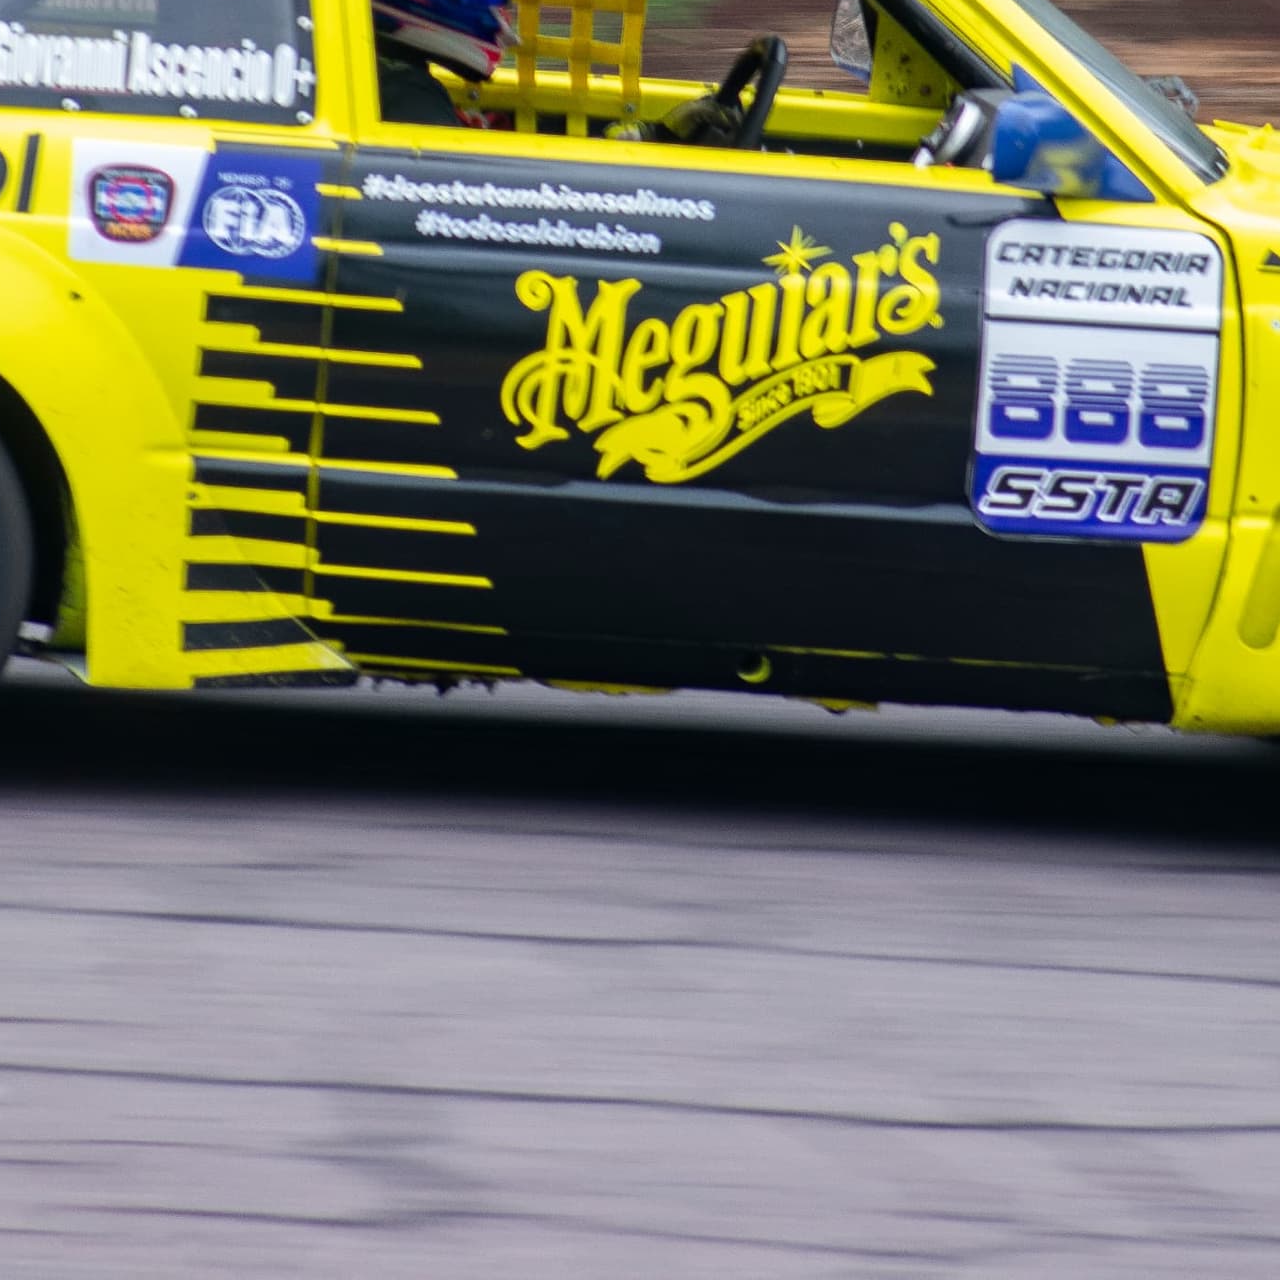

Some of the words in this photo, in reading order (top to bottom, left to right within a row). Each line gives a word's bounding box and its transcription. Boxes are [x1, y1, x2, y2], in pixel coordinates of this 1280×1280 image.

[128, 31, 273, 105] Ascencio
[362, 173, 716, 221] #deestatambiensalimos
[414, 209, 662, 254] #todosaldrabien
[996, 241, 1211, 274] CATEGORIA
[1006, 277, 1193, 308] NACIONAL
[500, 221, 943, 451] Meguiar's
[978, 465, 1205, 526] SSTA
